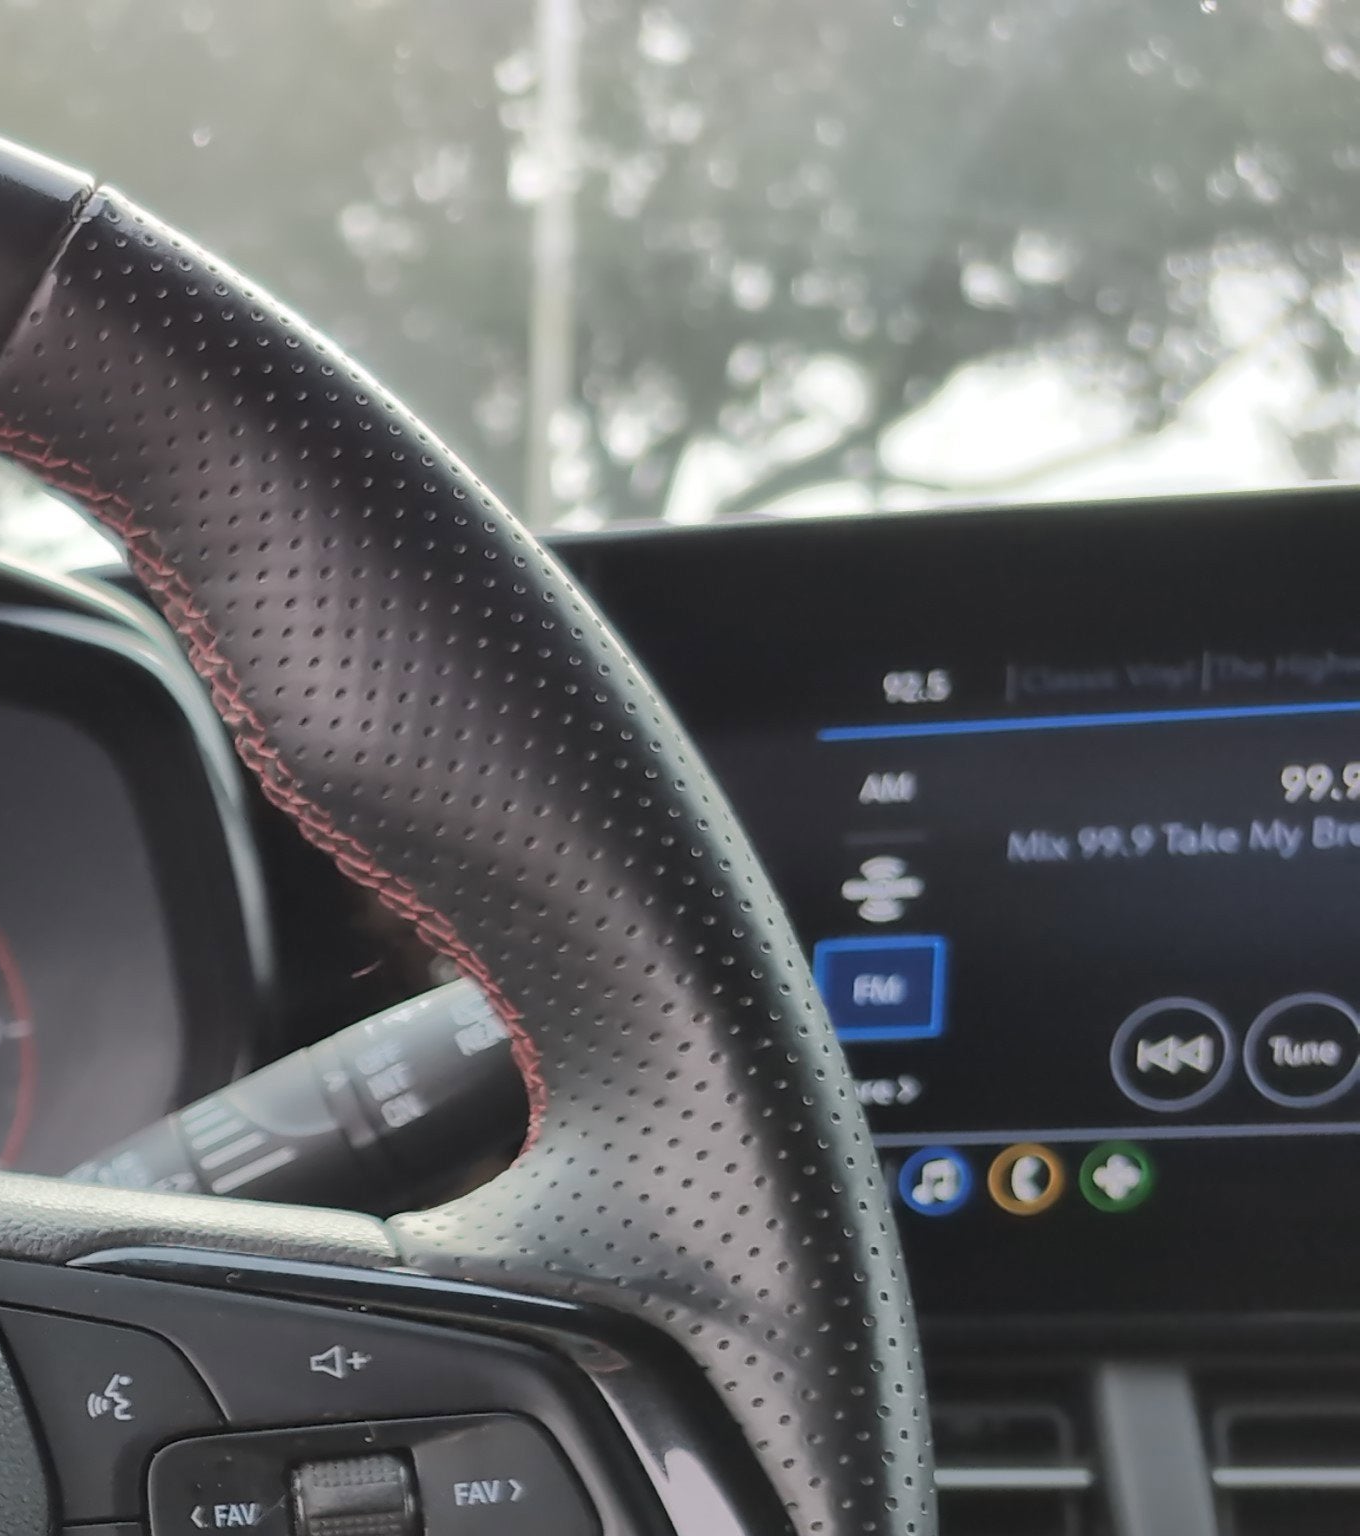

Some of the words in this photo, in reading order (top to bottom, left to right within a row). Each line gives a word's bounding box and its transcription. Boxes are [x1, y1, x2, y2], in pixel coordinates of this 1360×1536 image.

[859, 772, 917, 804] AM
[1007, 830, 1070, 862] Mix
[1078, 825, 1156, 858] 99.9
[1162, 820, 1241, 856] Take
[1249, 818, 1303, 860] My
[453, 1479, 501, 1506] FAV
[213, 1502, 262, 1528] FAV
